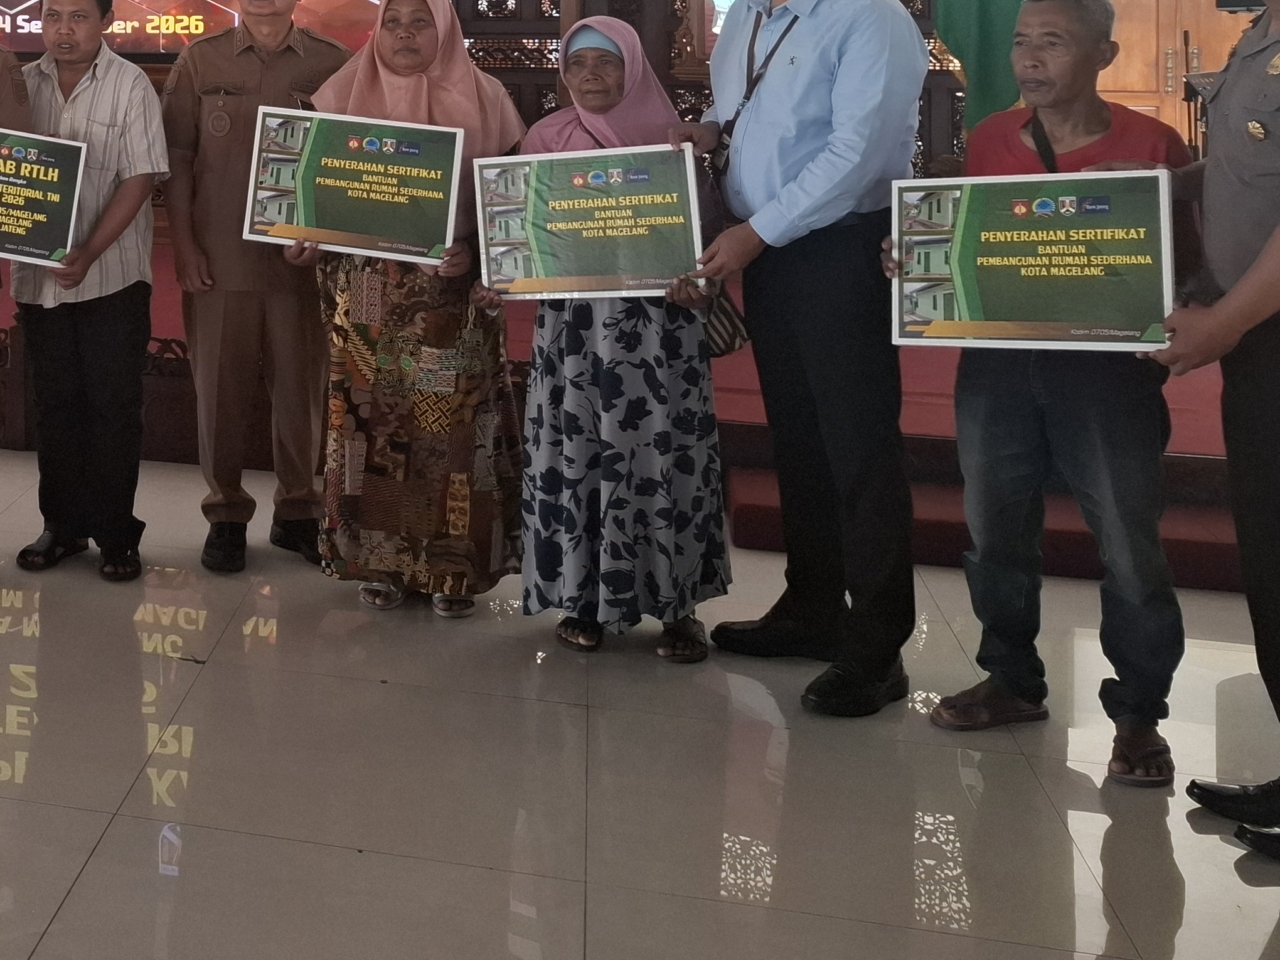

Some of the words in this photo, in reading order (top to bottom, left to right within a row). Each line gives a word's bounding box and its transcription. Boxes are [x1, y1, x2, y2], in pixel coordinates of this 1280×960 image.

[145, 15, 204, 34] 2026
[20, 162, 59, 182] RTLH
[321, 158, 384, 173] PENYERAHAN
[387, 165, 443, 180] SERTIFIKAT
[363, 174, 397, 185] BANTUAN
[0, 184, 44, 200] TERITORIAL
[47, 192, 60, 202] TNI
[316, 177, 370, 190] PEMBANGUNAN
[371, 184, 397, 194] RUMAH
[400, 187, 444, 199] SEDERHANA
[2, 194, 25, 206] 2026
[348, 190, 368, 199] KOTA
[370, 193, 409, 204] MAGELANG
[548, 197, 616, 210] PENYERAHAN
[618, 193, 678, 205] SERTIFIKAT
[595, 209, 632, 219] BANTUAN
[0, 224, 26, 235] JATENG
[547, 220, 604, 230] PEMBANGUNAN
[606, 219, 634, 227] RUMAH
[637, 215, 684, 225] SEDERHANA
[582, 229, 604, 238] KOTA
[606, 227, 649, 236] MAGELANG
[981, 231, 1066, 242] PENYERAHAN
[1069, 228, 1146, 240] SERTIFIKAT
[1038, 245, 1085, 254] BANTUAN
[977, 257, 1049, 266] PEMBANGUNAN
[1052, 256, 1088, 265] RUMAH
[1090, 255, 1152, 264] SEDERHANA
[1021, 267, 1048, 276] KOTA
[1051, 267, 1105, 276] MAGELANG
